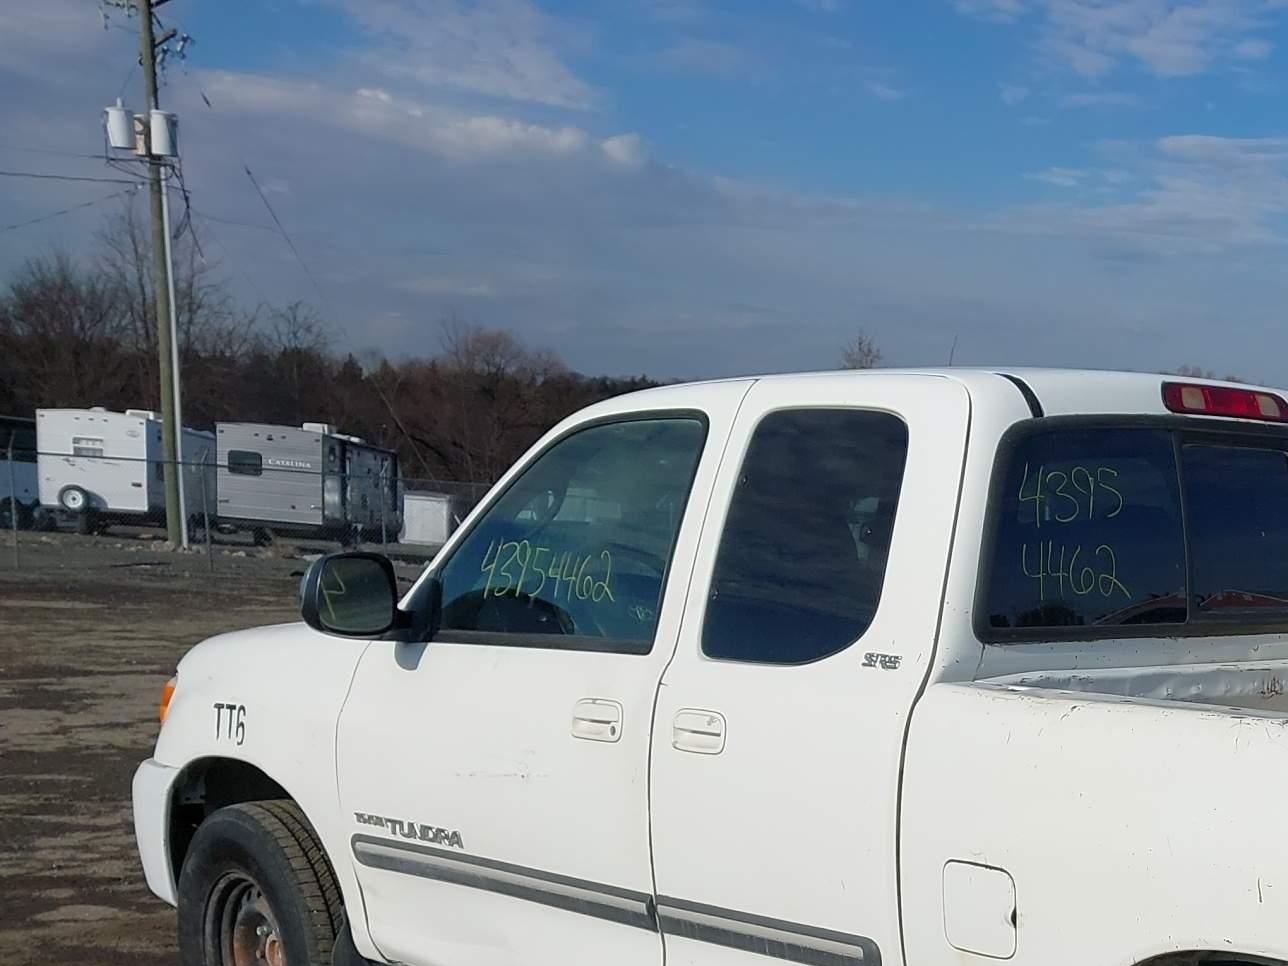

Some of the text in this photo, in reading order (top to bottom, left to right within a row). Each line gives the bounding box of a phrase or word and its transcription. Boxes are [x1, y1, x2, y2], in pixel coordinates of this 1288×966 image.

[268, 458, 312, 469] CATALINA
[1018, 461, 1123, 529] 4395
[480, 536, 616, 602] 43954462
[1022, 539, 1132, 601] 4462
[213, 702, 246, 746] TT6
[384, 817, 464, 849] TUNDRA
